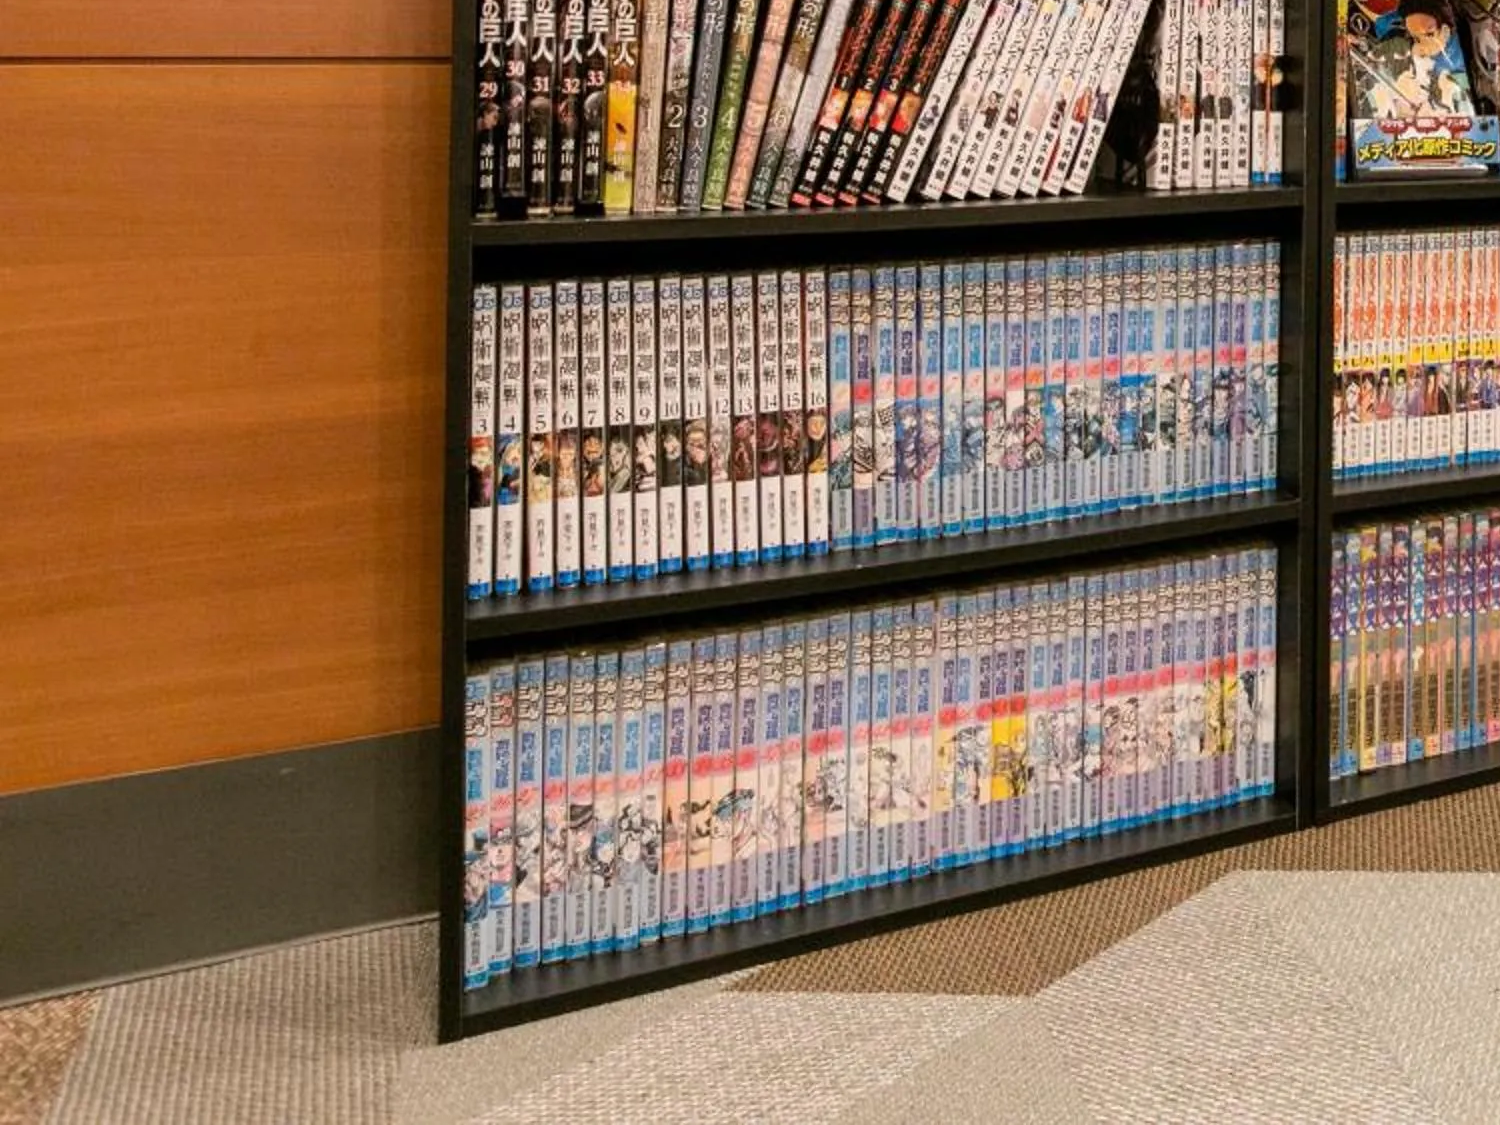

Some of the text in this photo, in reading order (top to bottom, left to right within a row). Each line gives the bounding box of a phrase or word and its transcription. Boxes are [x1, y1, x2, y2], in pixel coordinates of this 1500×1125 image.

[506, 60, 524, 76] 30
[532, 76, 550, 93] 31
[587, 70, 604, 86] 33
[479, 81, 497, 98] 29
[561, 78, 579, 95] 32
[668, 106, 684, 127] 2
[694, 107, 707, 127] 3
[721, 108, 736, 127] 4
[737, 398, 752, 413] 13
[763, 395, 777, 409] 14
[786, 393, 800, 407] 15
[810, 392, 824, 406] 16
[615, 408, 625, 421] 8
[639, 407, 650, 421] 9
[664, 402, 680, 416] 10
[688, 402, 702, 416] 11
[714, 400, 729, 414] 12
[506, 416, 516, 432] 4
[535, 415, 545, 431] 5
[561, 410, 572, 425] 6
[588, 410, 597, 425] 7
[478, 420, 488, 433] 3
